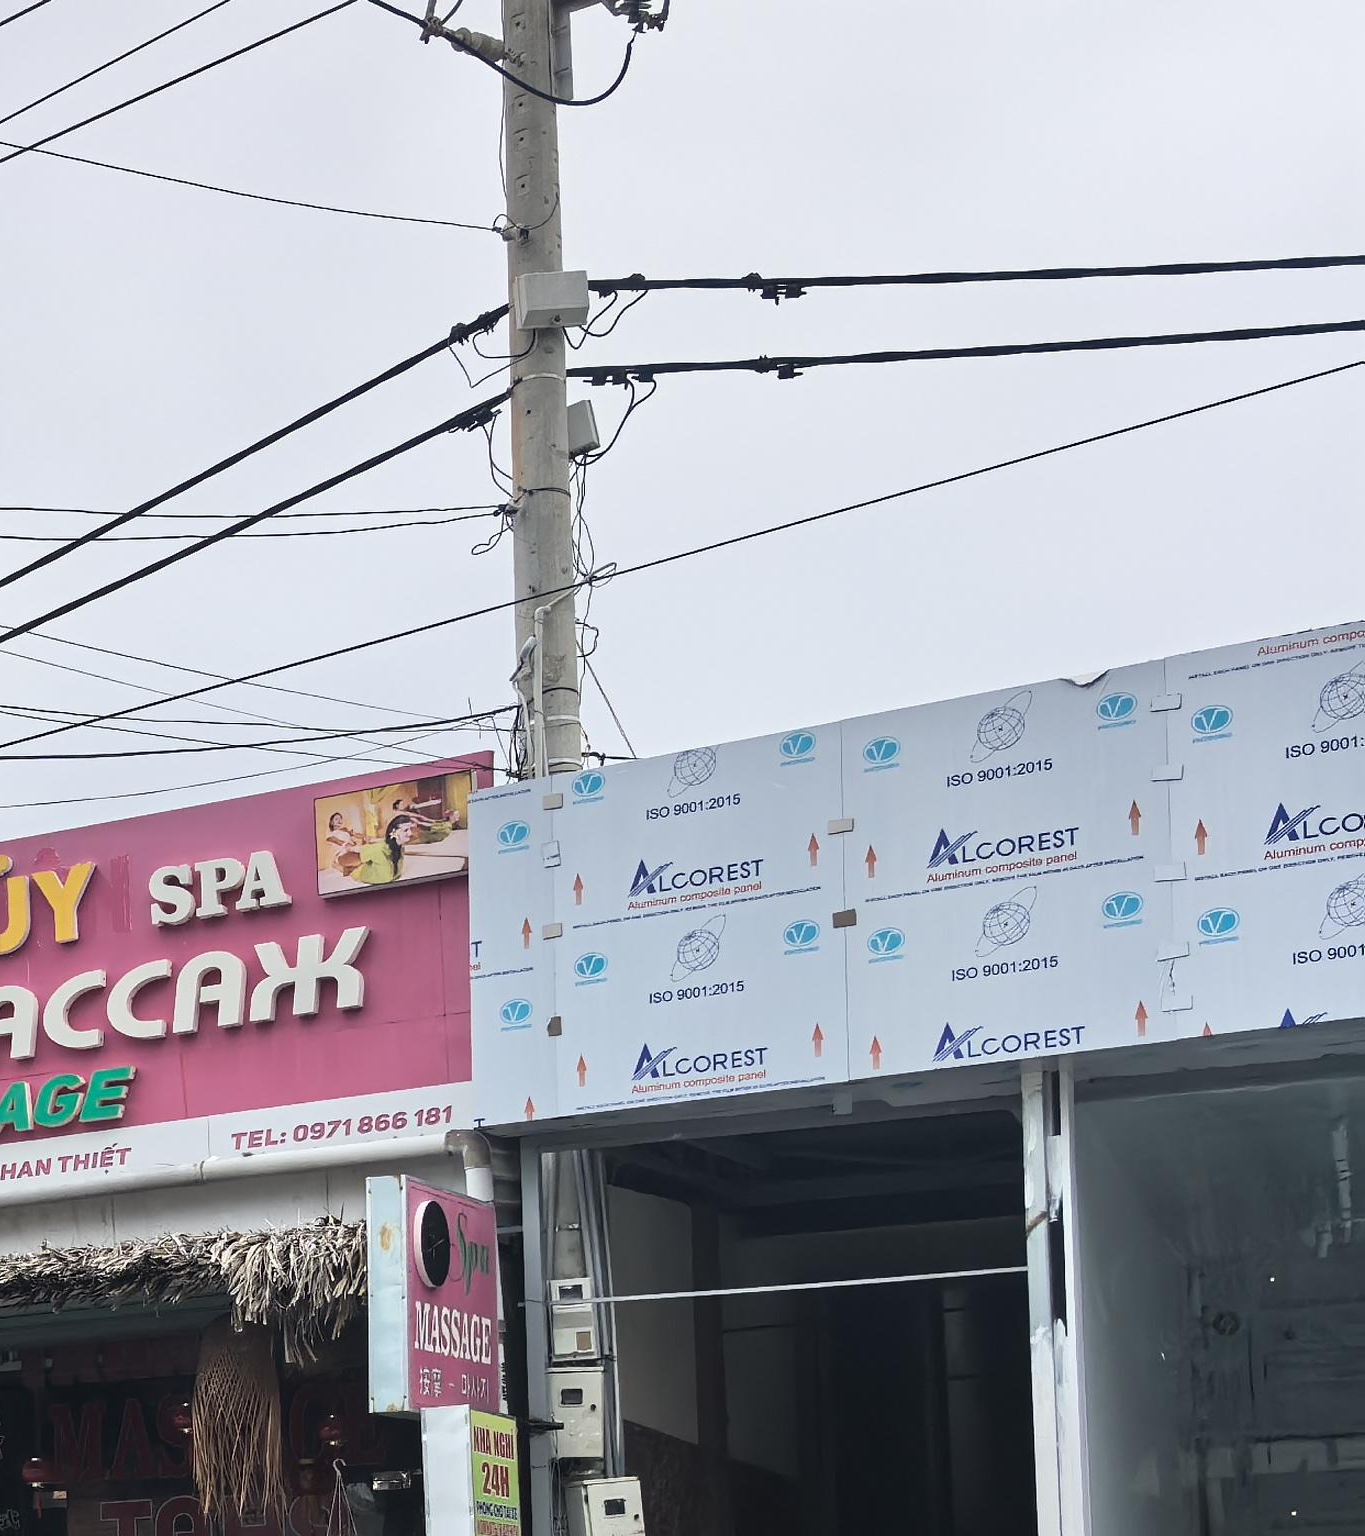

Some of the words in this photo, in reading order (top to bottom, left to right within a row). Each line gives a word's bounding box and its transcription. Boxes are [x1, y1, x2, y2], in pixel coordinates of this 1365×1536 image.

[946, 772, 973, 788] ISO
[977, 758, 1053, 782] 9001:2015
[646, 805, 669, 820] ISO
[673, 794, 741, 818] 9001:2015
[927, 828, 1079, 868] ALCOREST
[628, 858, 764, 898] ALCOREST
[927, 868, 981, 884] Aluminum
[985, 857, 1043, 875] composite
[1045, 851, 1077, 868] panel
[149, 850, 293, 928] SPA
[628, 895, 677, 910] Aluminum
[679, 887, 731, 903] composite
[734, 881, 761, 895] panel
[231, 1131, 287, 1151] TEL:
[293, 1119, 351, 1143] 0971
[357, 1111, 407, 1134] 866
[415, 1104, 453, 1126] 181
[451, 1212, 489, 1296] Spa
[415, 1301, 491, 1365] MASSAGE
[473, 1425, 491, 1456] NHÀ
[481, 1462, 509, 1498] 24H
